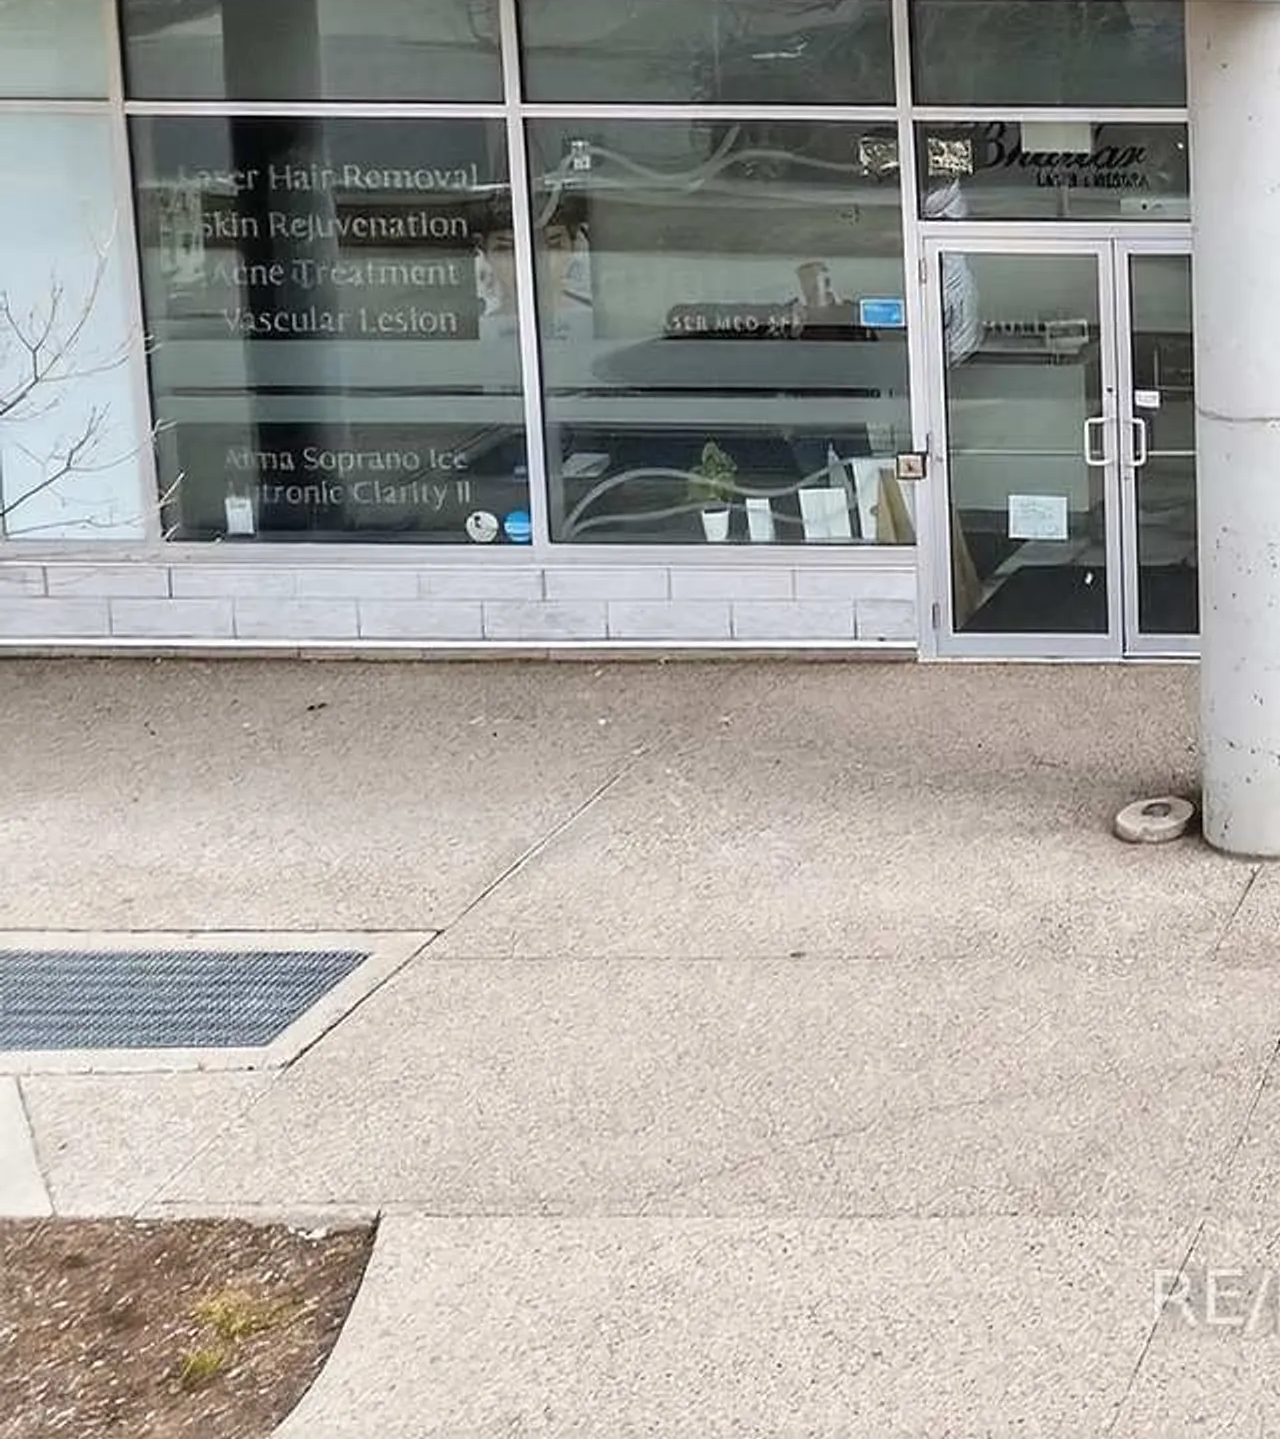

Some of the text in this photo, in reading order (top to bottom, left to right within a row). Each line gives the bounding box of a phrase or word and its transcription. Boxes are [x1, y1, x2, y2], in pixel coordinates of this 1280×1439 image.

[268, 163, 334, 191] Hair
[342, 162, 479, 189] Removal
[200, 212, 469, 242] Skin Rejuvenation
[209, 259, 460, 287] Acne Treatment
[223, 307, 458, 333] Vascular Lesion
[302, 447, 420, 476] Soprano
[430, 449, 469, 470] Ice
[352, 480, 448, 510] Clarity
